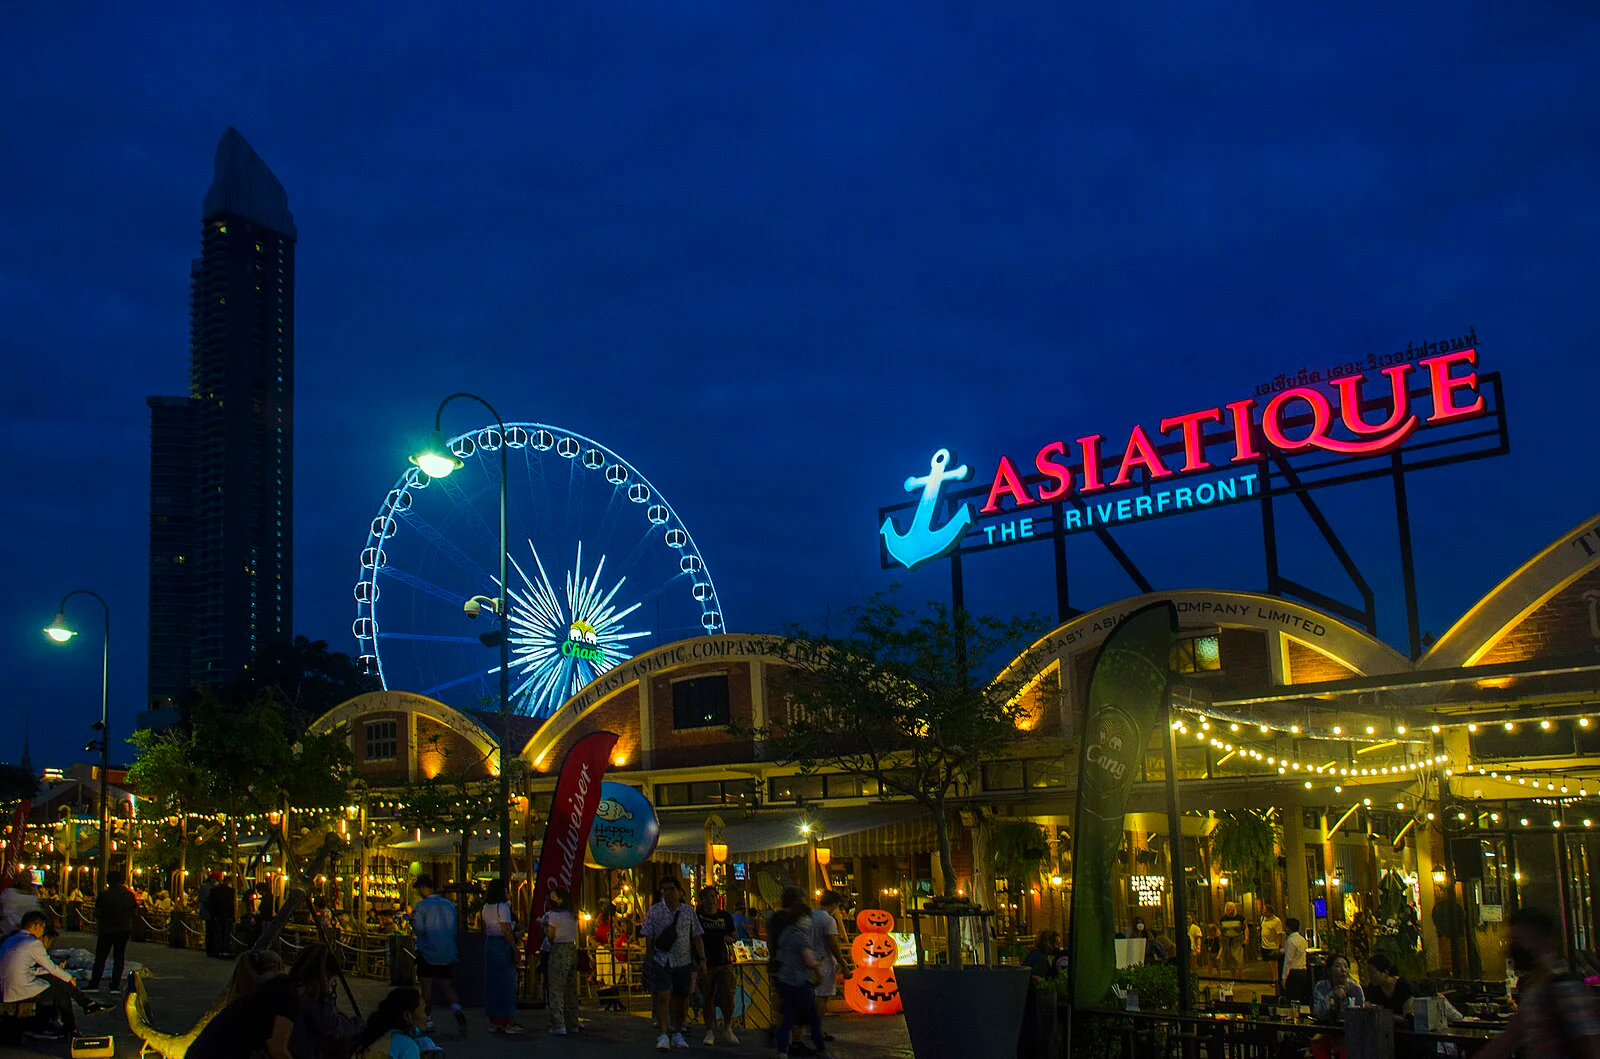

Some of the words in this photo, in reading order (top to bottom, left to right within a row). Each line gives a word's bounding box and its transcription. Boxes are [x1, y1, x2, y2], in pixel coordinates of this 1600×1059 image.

[979, 347, 1484, 513] ASIATIQUE
[983, 517, 1035, 545] THE
[1065, 474, 1258, 530] RIVERFRONT
[1177, 602, 1250, 616] OMPANY
[1257, 607, 1326, 637] LIMITED
[561, 640, 605, 666] Chang
[571, 692, 594, 714] THE
[596, 671, 625, 698] EAST
[632, 646, 685, 678] ASIATIC
[692, 640, 766, 658] COMPANY
[594, 823, 634, 838] Happy
[595, 835, 634, 848] Fish
